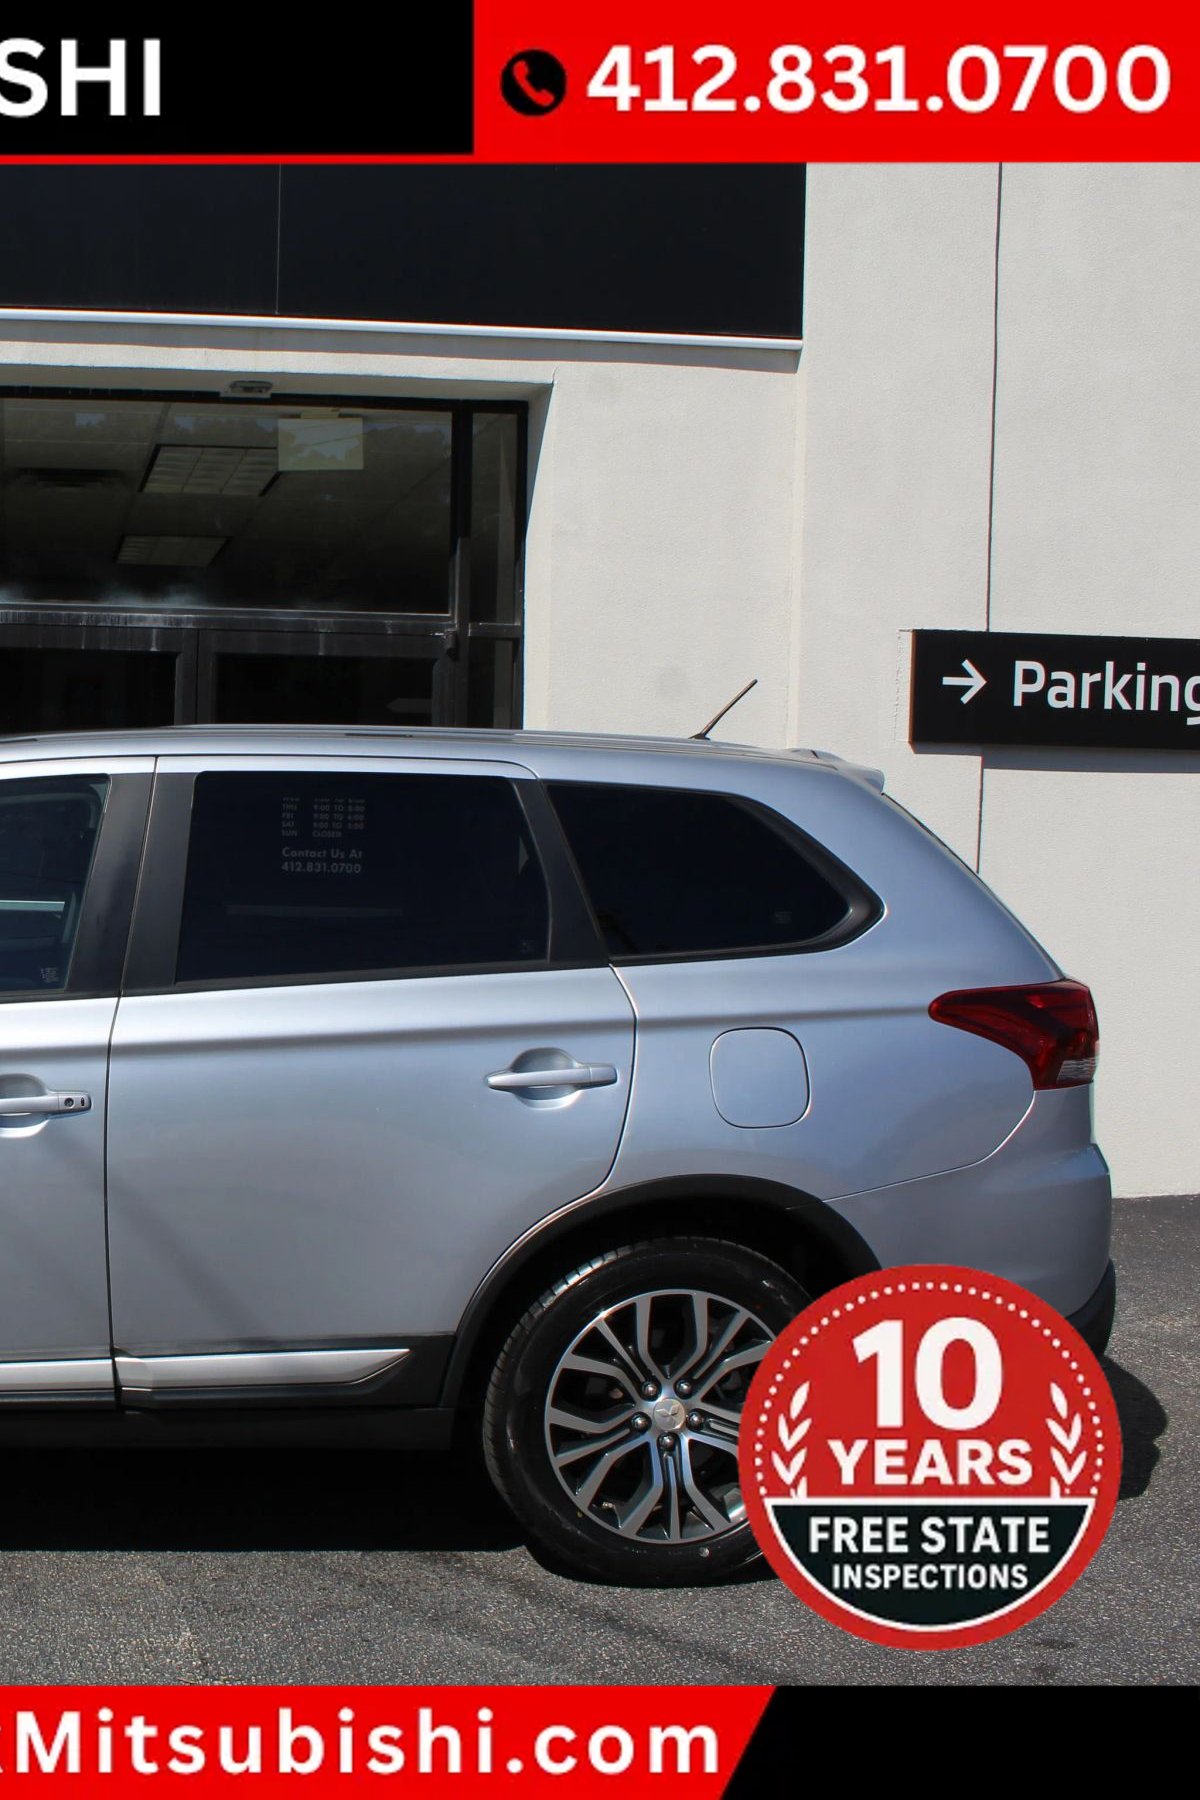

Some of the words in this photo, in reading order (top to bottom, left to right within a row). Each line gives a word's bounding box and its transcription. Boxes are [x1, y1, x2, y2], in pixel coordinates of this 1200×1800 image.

[282, 847, 327, 858] Contact
[331, 848, 345, 859] Us
[349, 849, 362, 859] At
[281, 861, 361, 873] 412.831.0700
